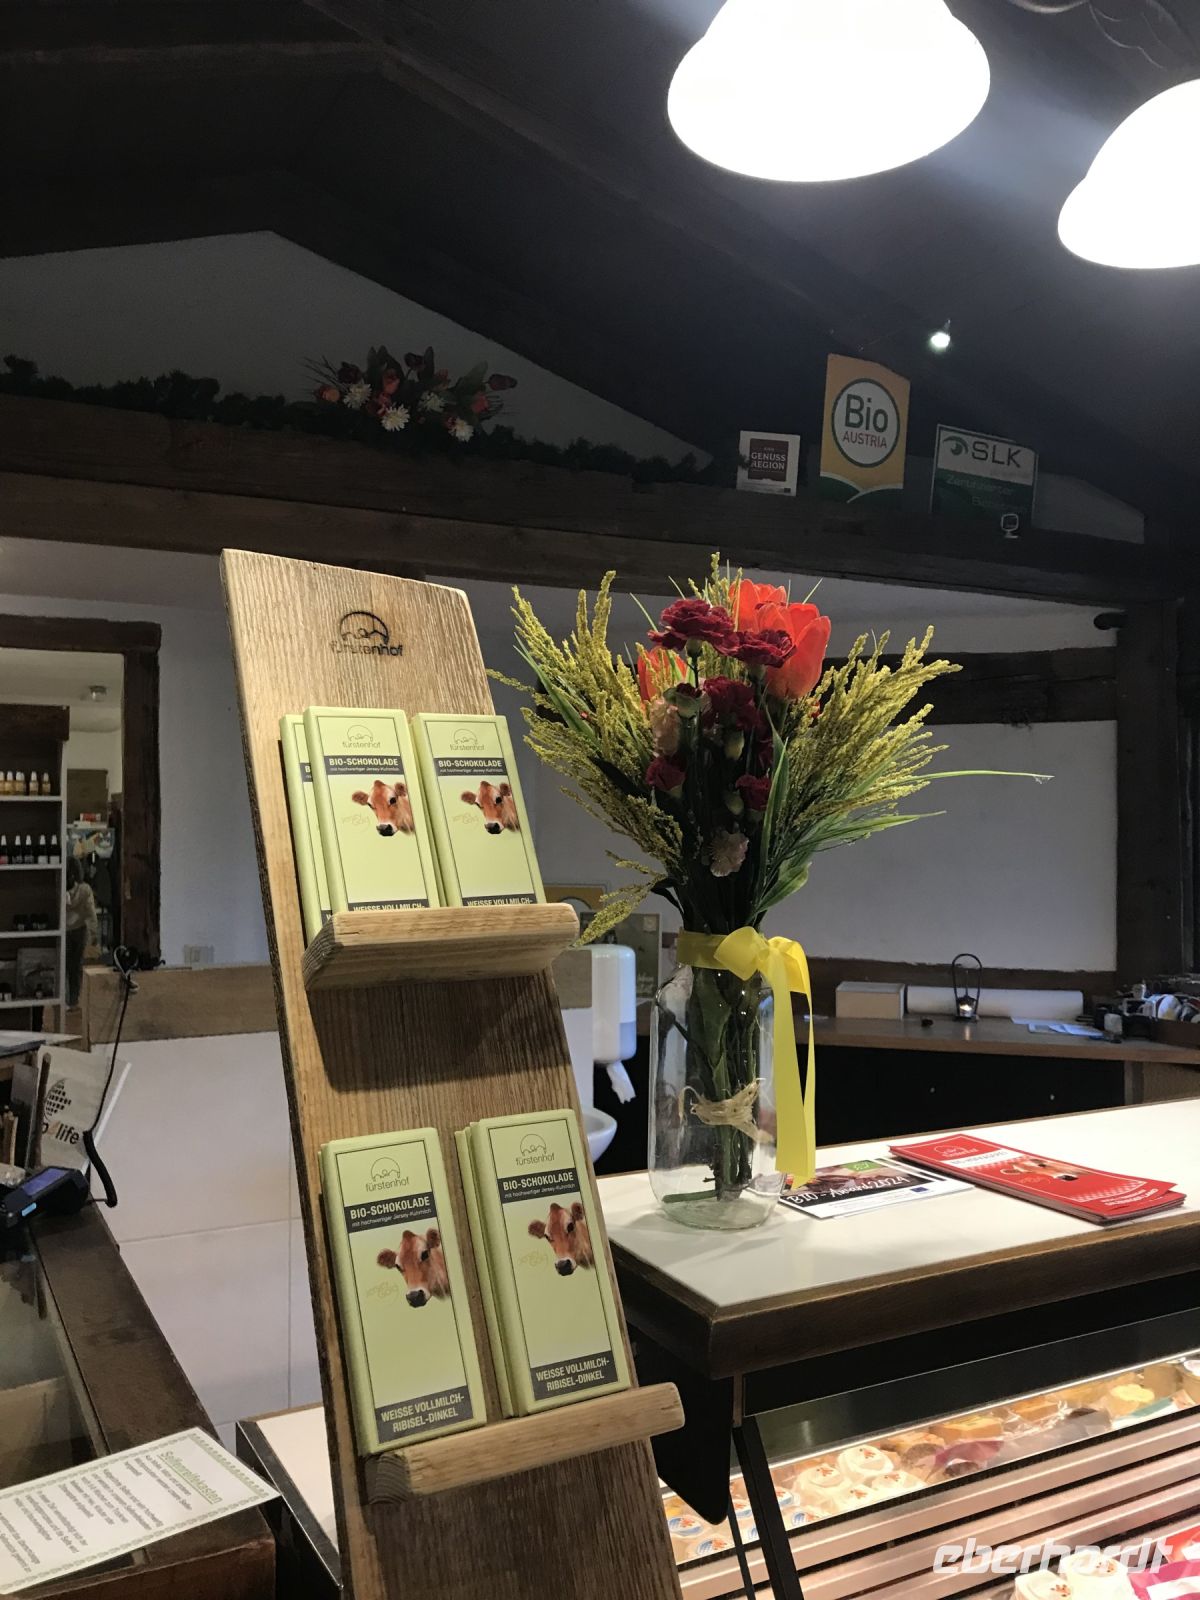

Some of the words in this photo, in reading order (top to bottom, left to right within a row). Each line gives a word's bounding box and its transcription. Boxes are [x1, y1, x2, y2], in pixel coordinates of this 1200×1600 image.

[844, 393, 889, 433] Bio
[842, 430, 888, 449] AUSTRIA
[751, 452, 786, 462] GENUSS
[971, 441, 1021, 468] SLK
[751, 460, 785, 470] REGION
[329, 756, 399, 768] BIO-SCHOKOLADE
[438, 760, 503, 768] BIO-SCHOKOLADE
[515, 1152, 555, 1166] fürstenhof
[365, 1176, 410, 1192] fürstenhof
[502, 1171, 574, 1191] BIO-SCHOKOLADE
[786, 1192, 818, 1205] BIO
[829, 1182, 873, 1198] Award
[350, 1196, 431, 1220] BIO-SCHOKOLADE
[535, 1366, 567, 1382] WEISSE
[567, 1357, 610, 1376] VOLLMILCH-
[546, 1371, 605, 1392] RIBISEL-DINKEL
[381, 1403, 413, 1423] WEISSE
[413, 1392, 465, 1416] VOLLMILCH-
[392, 1406, 459, 1433] RIBISEL-DINKEL
